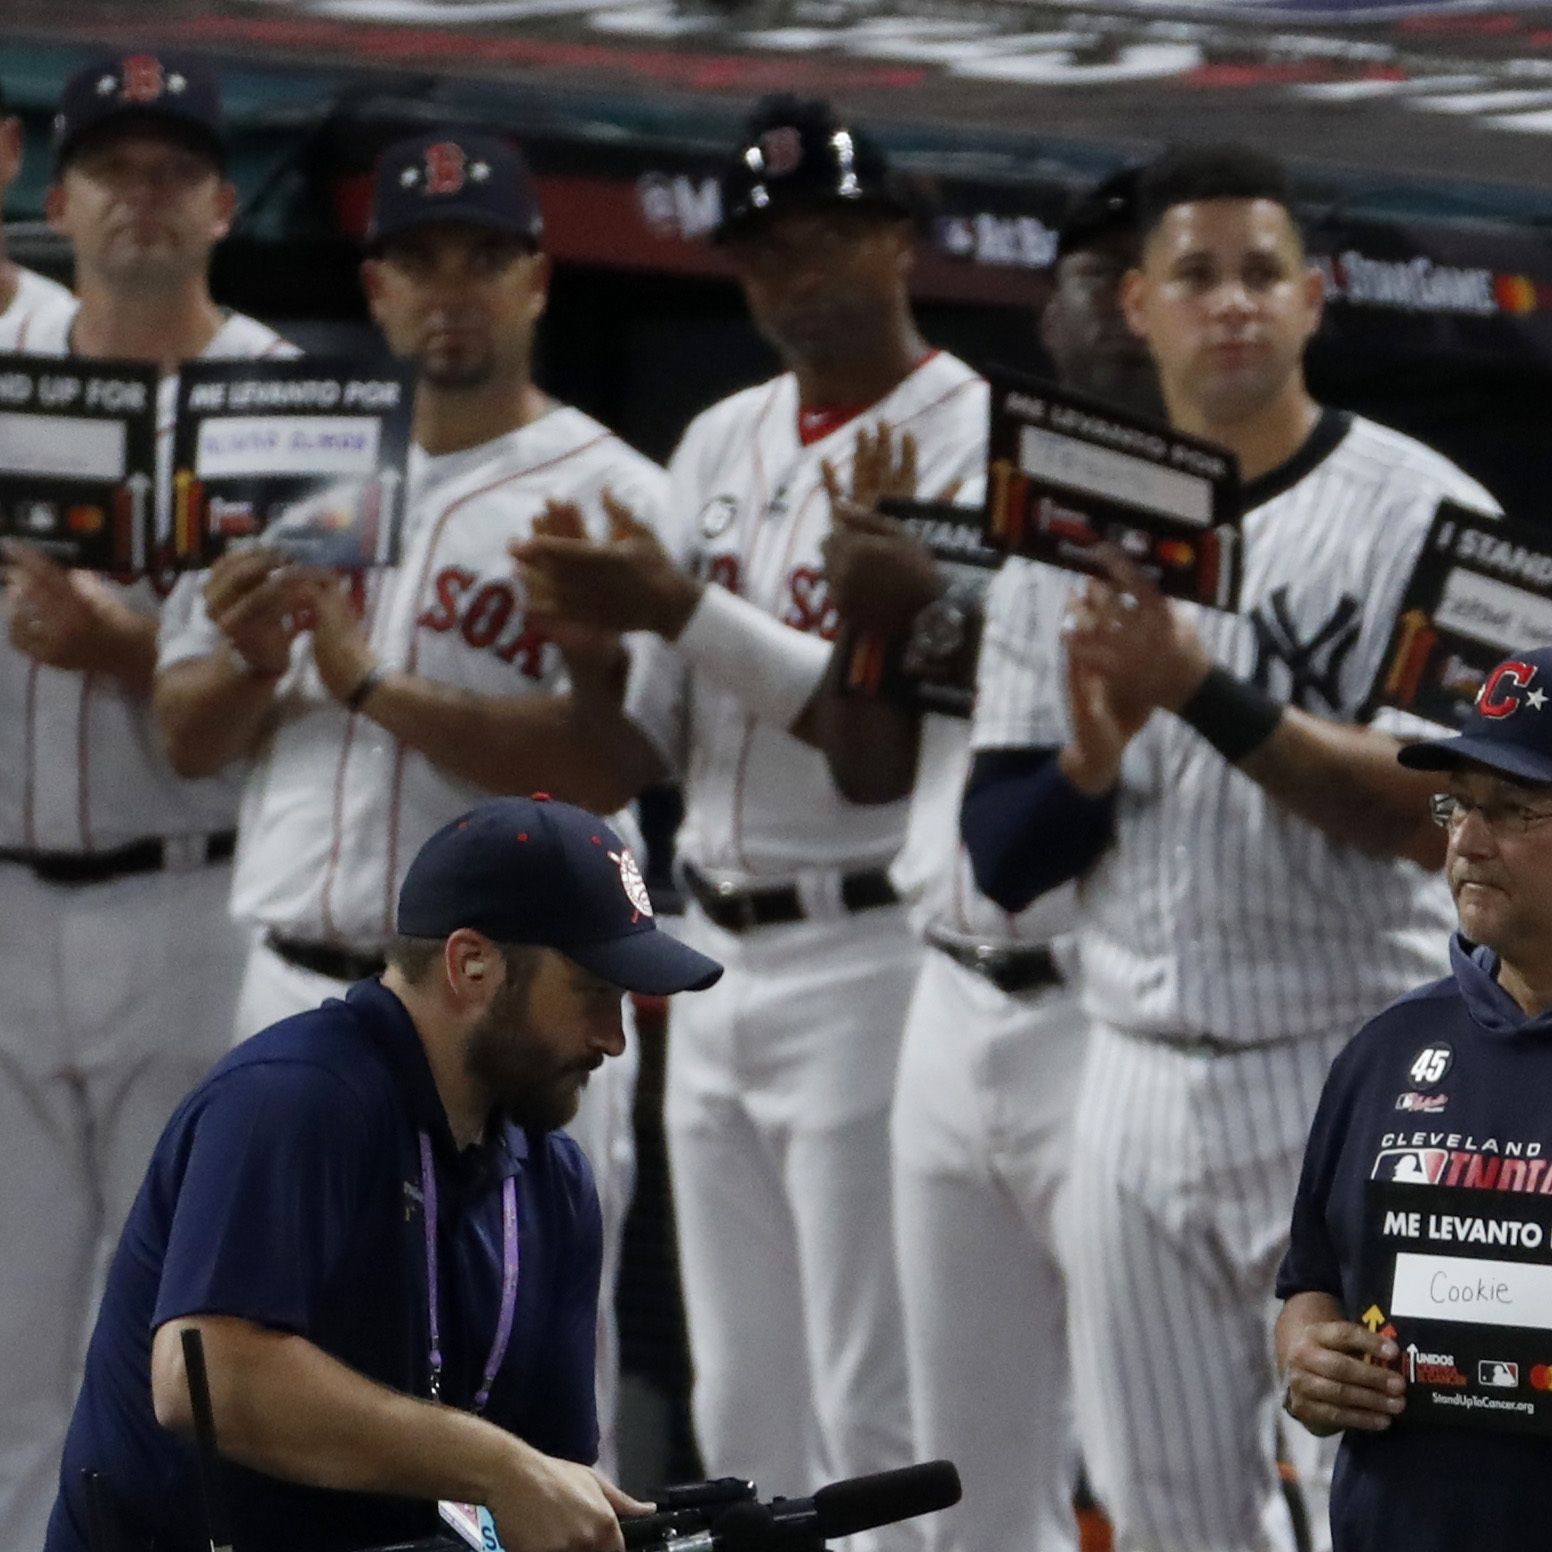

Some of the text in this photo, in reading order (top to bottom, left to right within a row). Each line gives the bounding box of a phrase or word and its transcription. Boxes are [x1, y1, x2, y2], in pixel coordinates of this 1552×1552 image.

[1477, 660, 1538, 719] C
[1410, 1048, 1450, 1083] 45
[1381, 1131, 1543, 1158] CLEVELAND
[1383, 1211, 1421, 1238] ME
[1428, 1214, 1543, 1249] LEVANTO
[1429, 1270, 1514, 1305] Cookie
[1415, 1352, 1455, 1367] UNIDOS
[1431, 1391, 1535, 1415] StandUpToCancer.org
